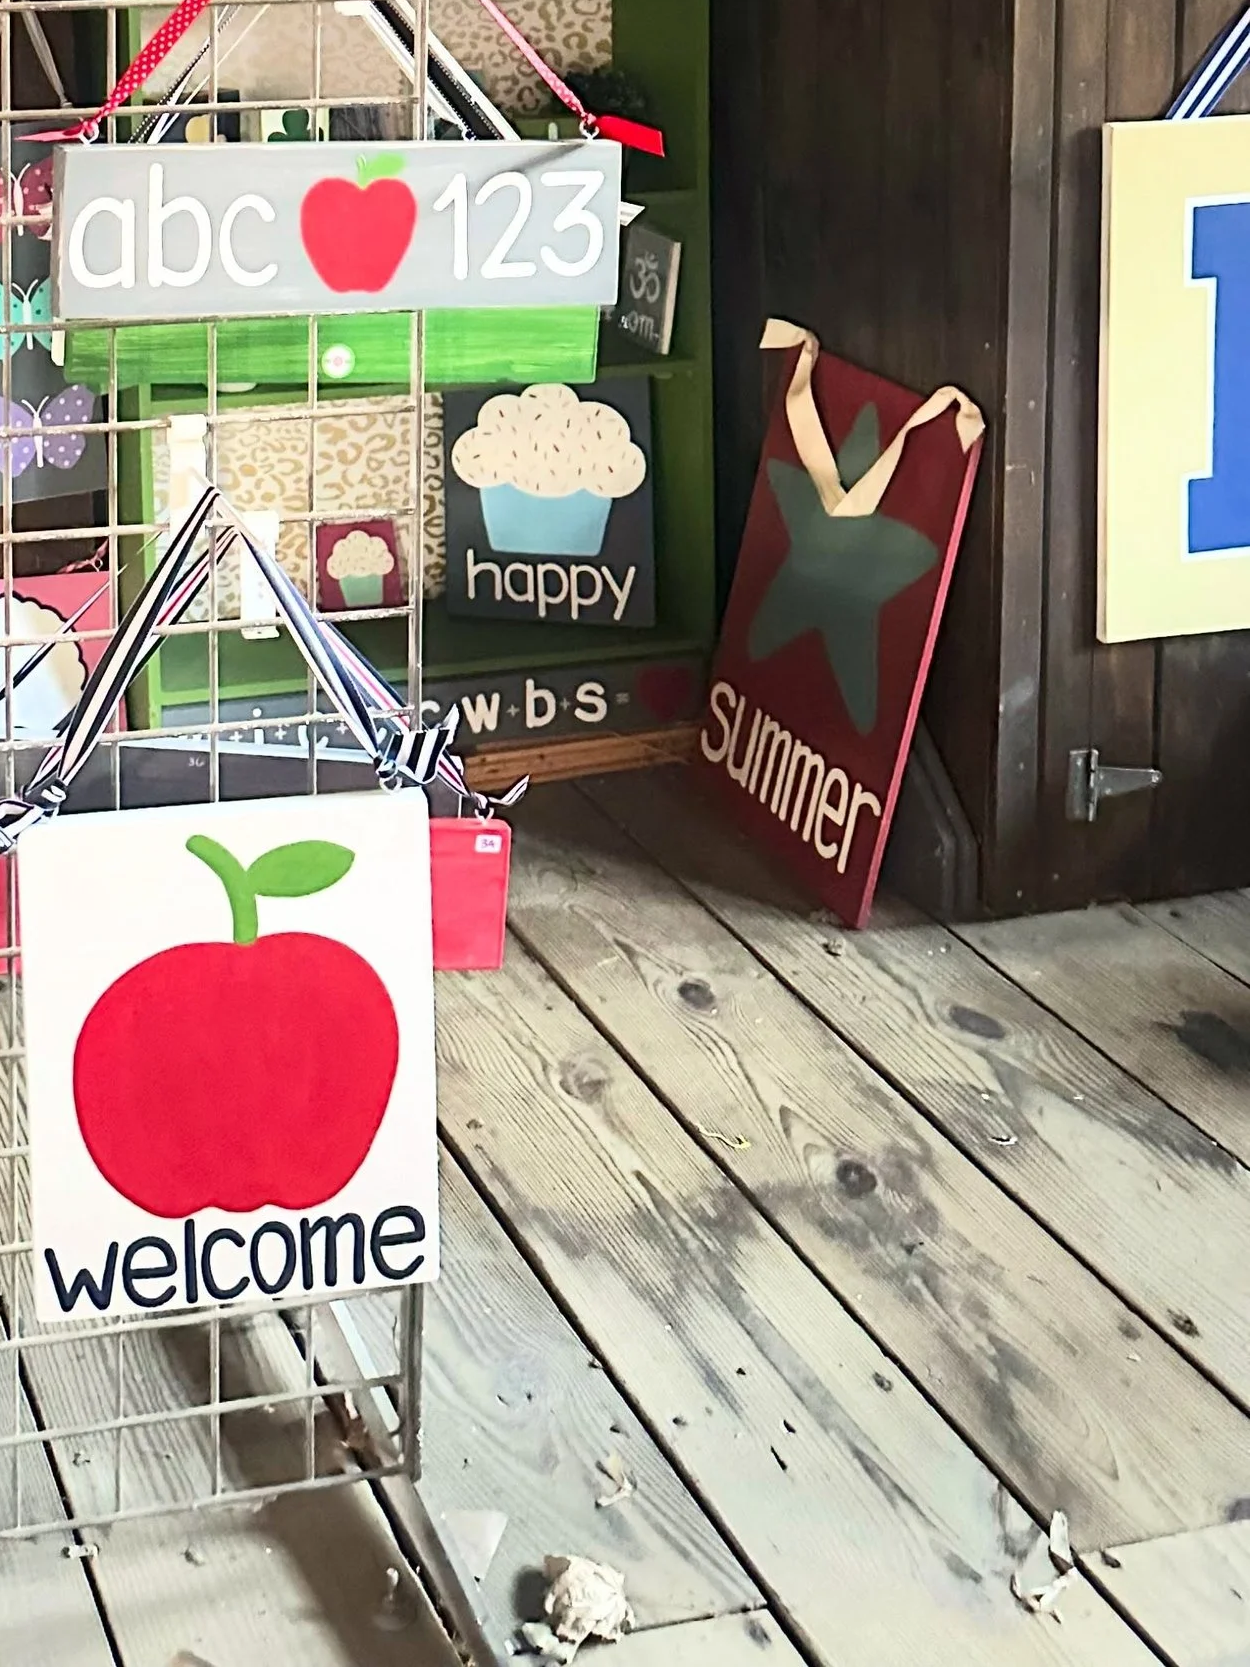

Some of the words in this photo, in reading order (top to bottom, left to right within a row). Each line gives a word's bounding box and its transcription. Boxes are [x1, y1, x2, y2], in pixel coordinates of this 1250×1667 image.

[67, 164, 279, 291] abc
[432, 169, 605, 281] 123
[466, 549, 637, 621] happy
[700, 681, 881, 875] summer
[45, 1205, 426, 1312] welcome
